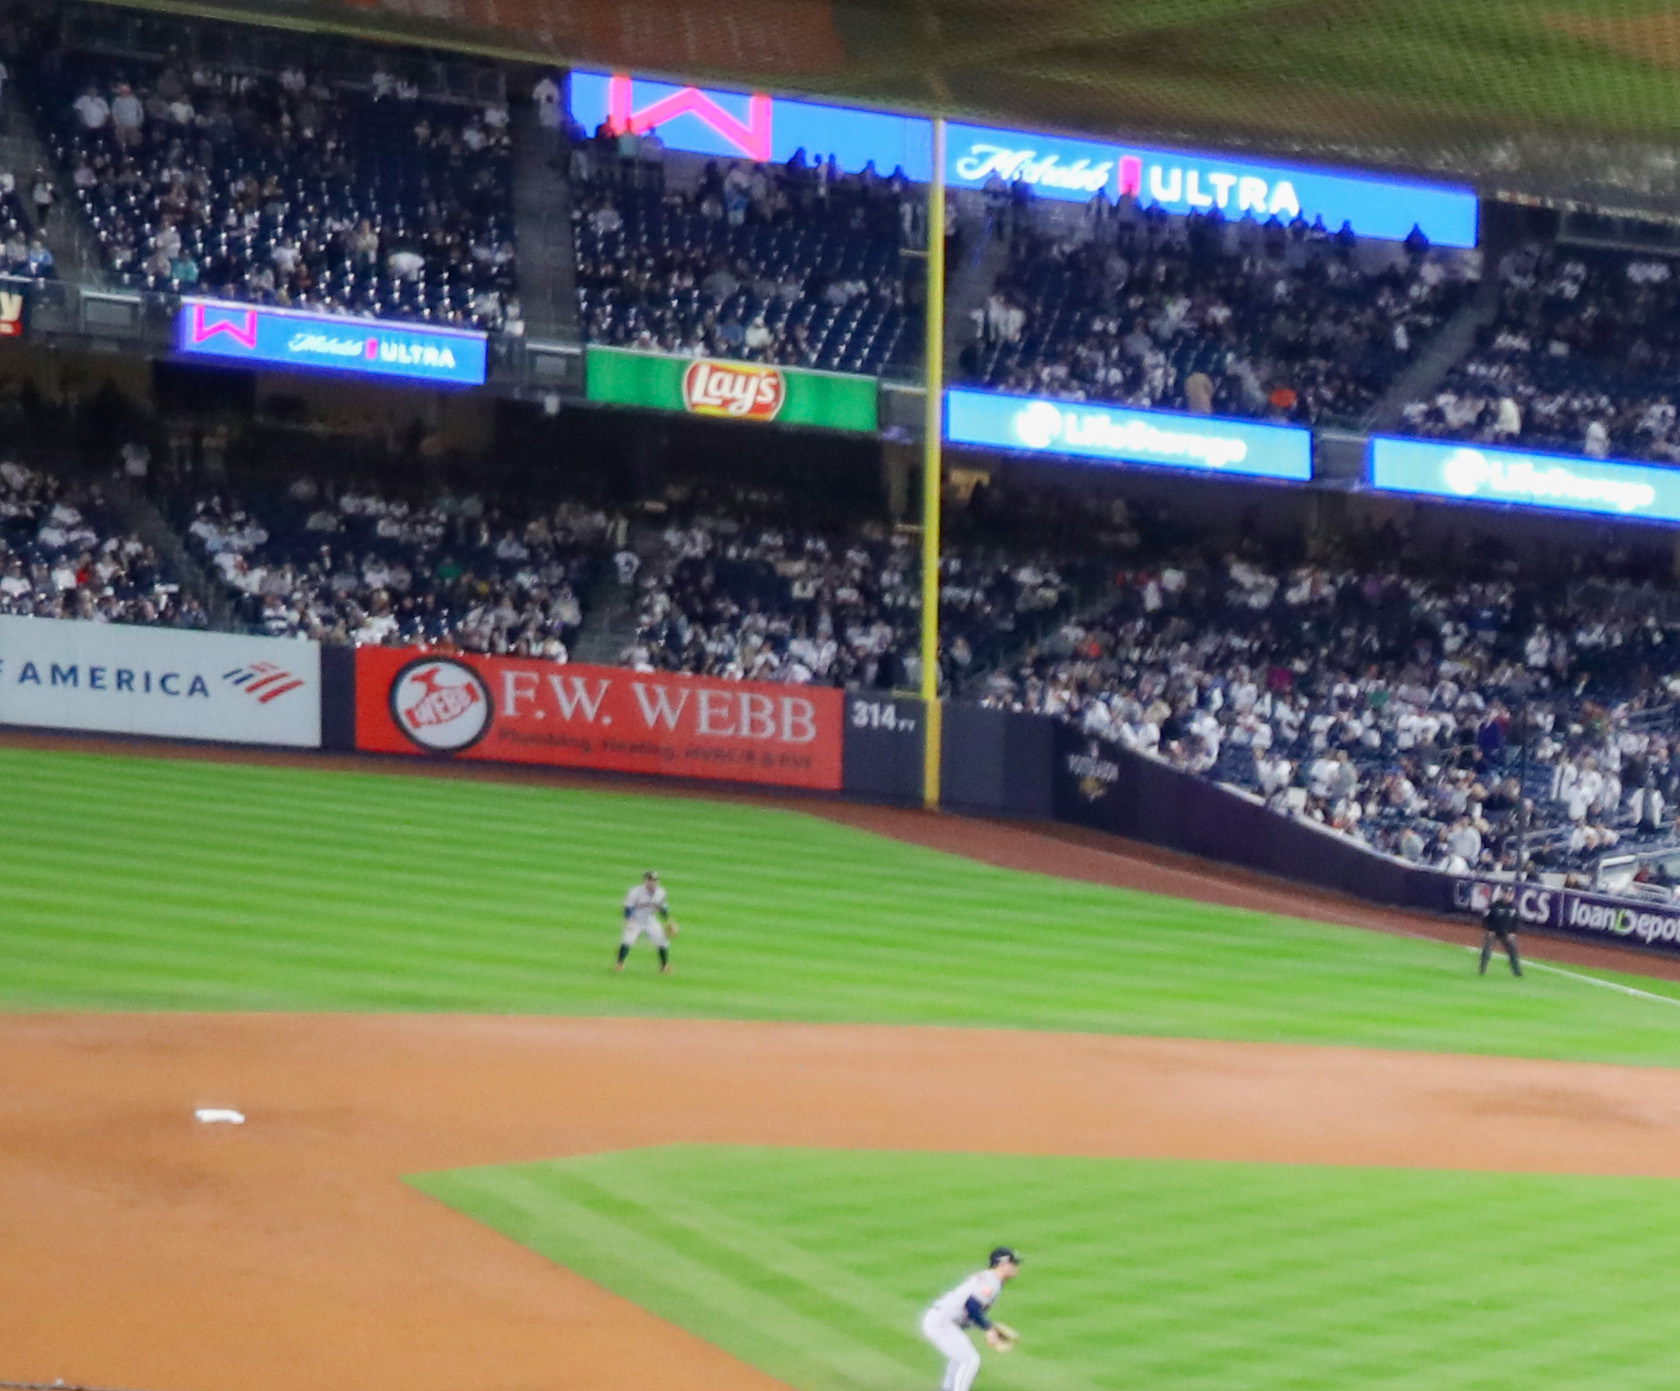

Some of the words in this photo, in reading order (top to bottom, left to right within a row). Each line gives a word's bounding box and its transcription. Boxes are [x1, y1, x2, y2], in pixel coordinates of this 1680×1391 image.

[955, 143, 1109, 191] Michelob
[1149, 166, 1301, 216] ULTRA
[379, 340, 456, 369] ULTRA
[688, 364, 780, 415] Lay's
[18, 661, 211, 699] AMERICA
[500, 670, 614, 727] F.W.
[630, 681, 818, 744] WEBB
[852, 700, 895, 730] 314
